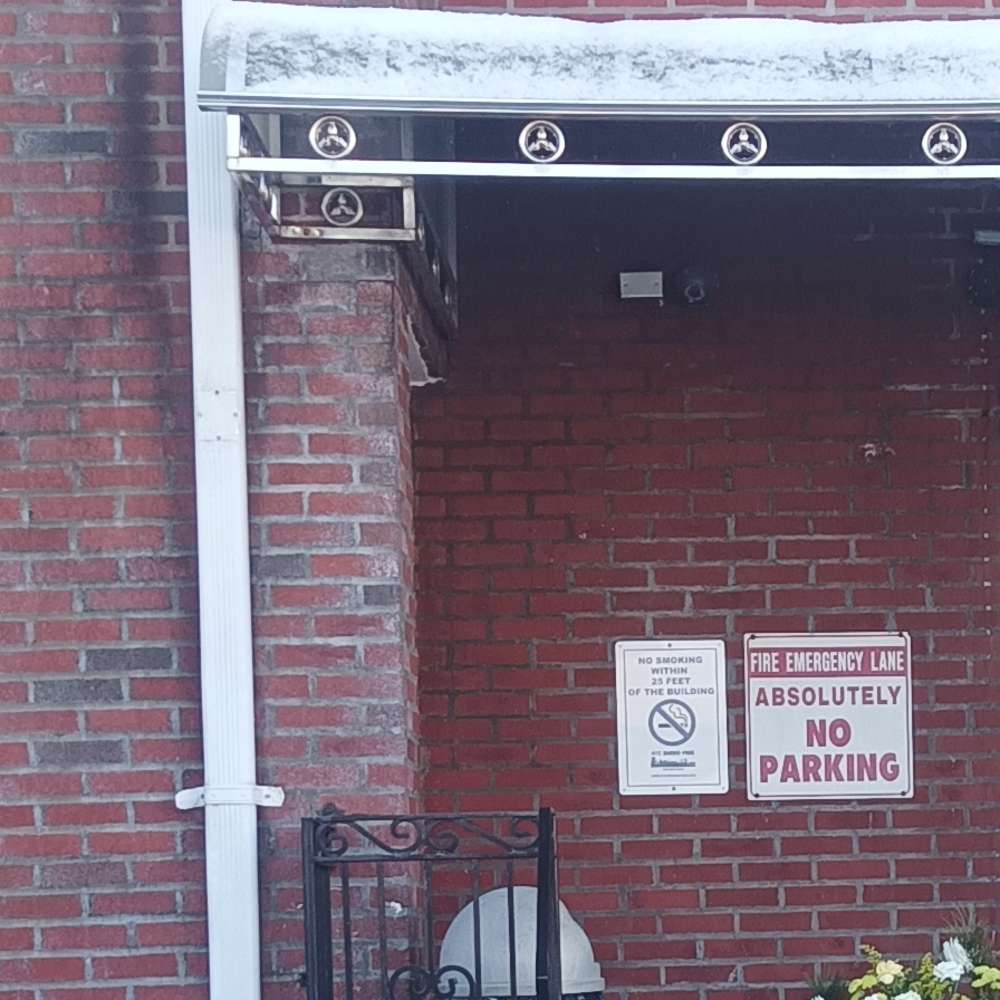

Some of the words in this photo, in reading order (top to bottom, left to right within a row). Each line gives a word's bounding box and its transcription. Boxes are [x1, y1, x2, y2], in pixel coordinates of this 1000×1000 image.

[656, 656, 703, 664] SMOKING
[750, 652, 779, 673] FIRE
[786, 651, 864, 672] EMERGENCY
[870, 650, 905, 671] LANE
[651, 667, 688, 675] WITHIN
[666, 677, 691, 685] FEET
[644, 688, 665, 696] THE
[667, 687, 715, 695] BUILDING
[755, 686, 902, 707] ABSOLUTELY
[806, 718, 852, 748] NO
[760, 752, 900, 783] PARKING
